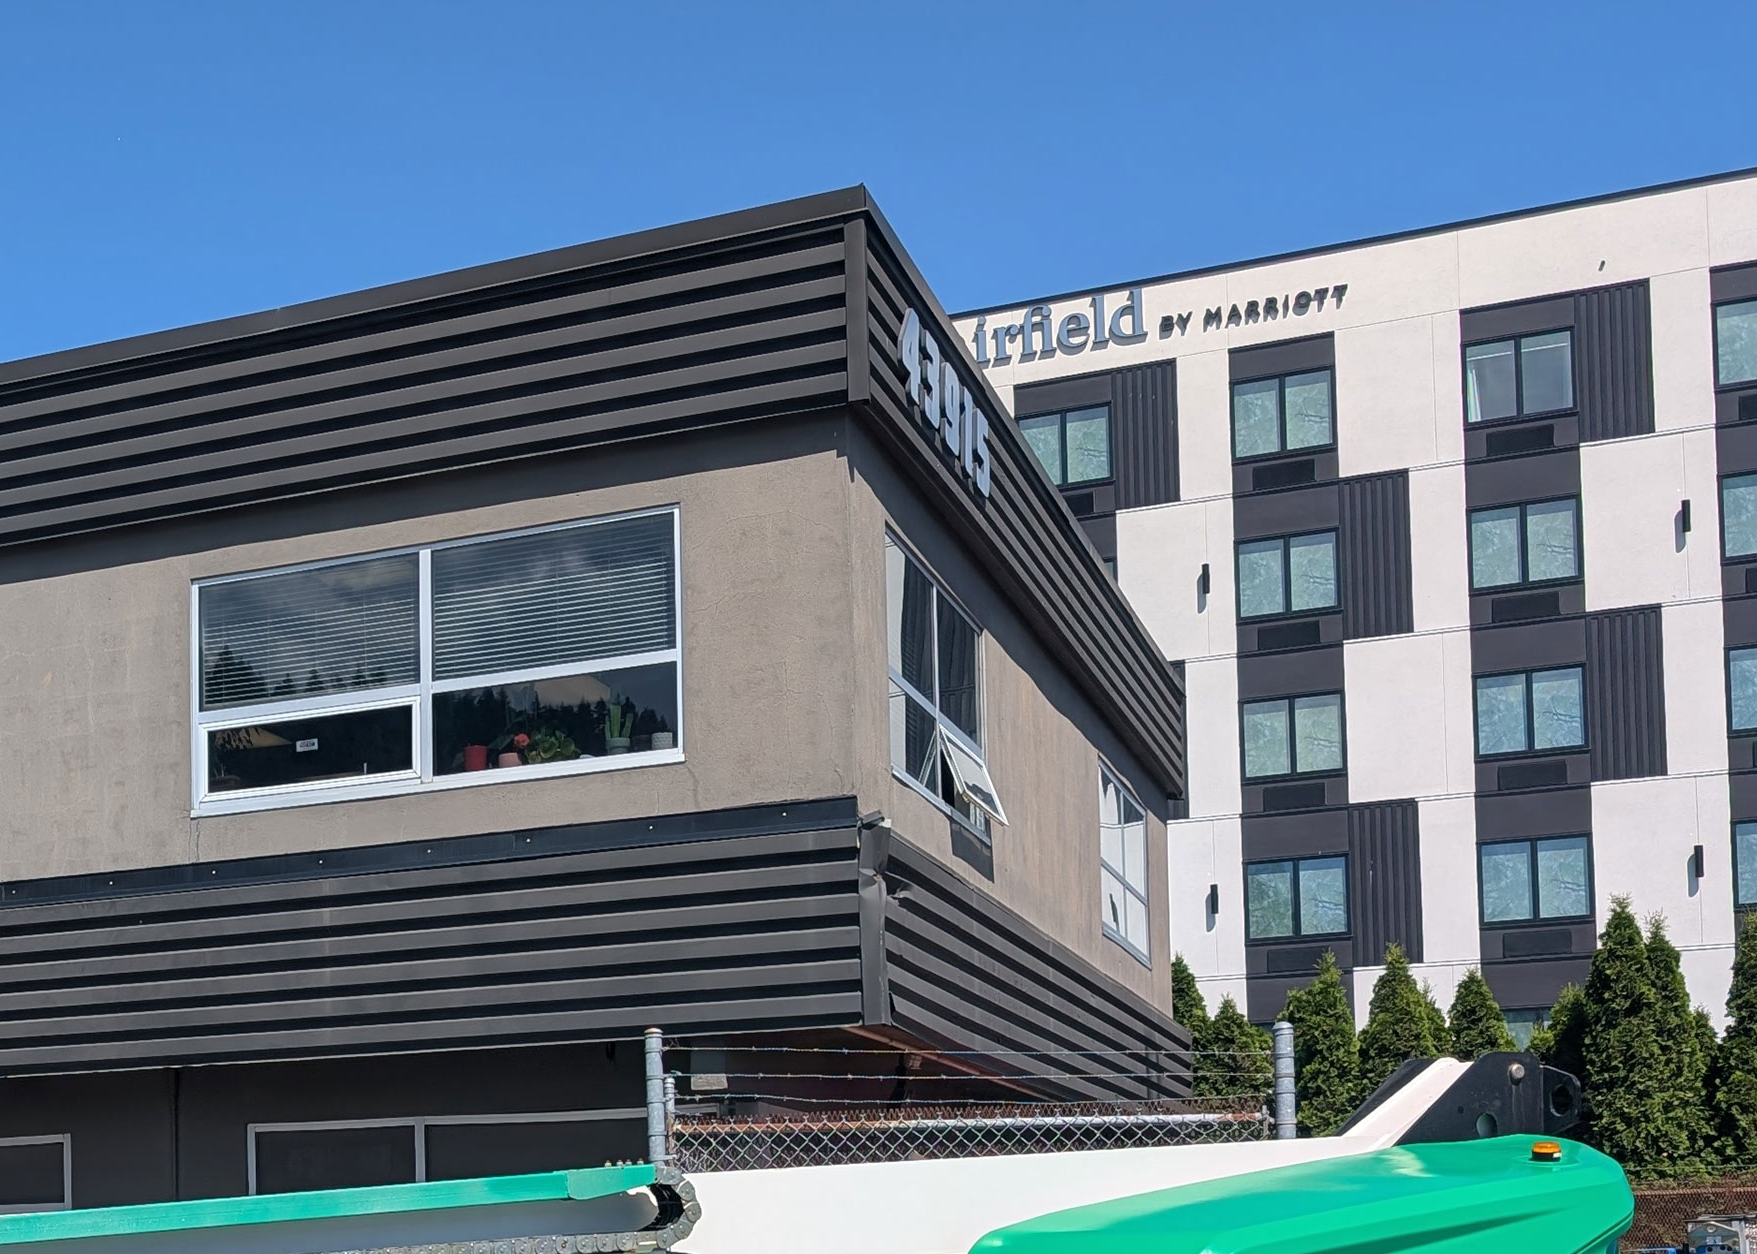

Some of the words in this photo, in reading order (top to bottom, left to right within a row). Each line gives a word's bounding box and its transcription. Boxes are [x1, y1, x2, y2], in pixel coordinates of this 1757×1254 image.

[972, 288, 1147, 363] irfield
[1159, 312, 1193, 339] BY
[1203, 284, 1348, 333] MARRIOTT
[897, 308, 991, 498] 43915
